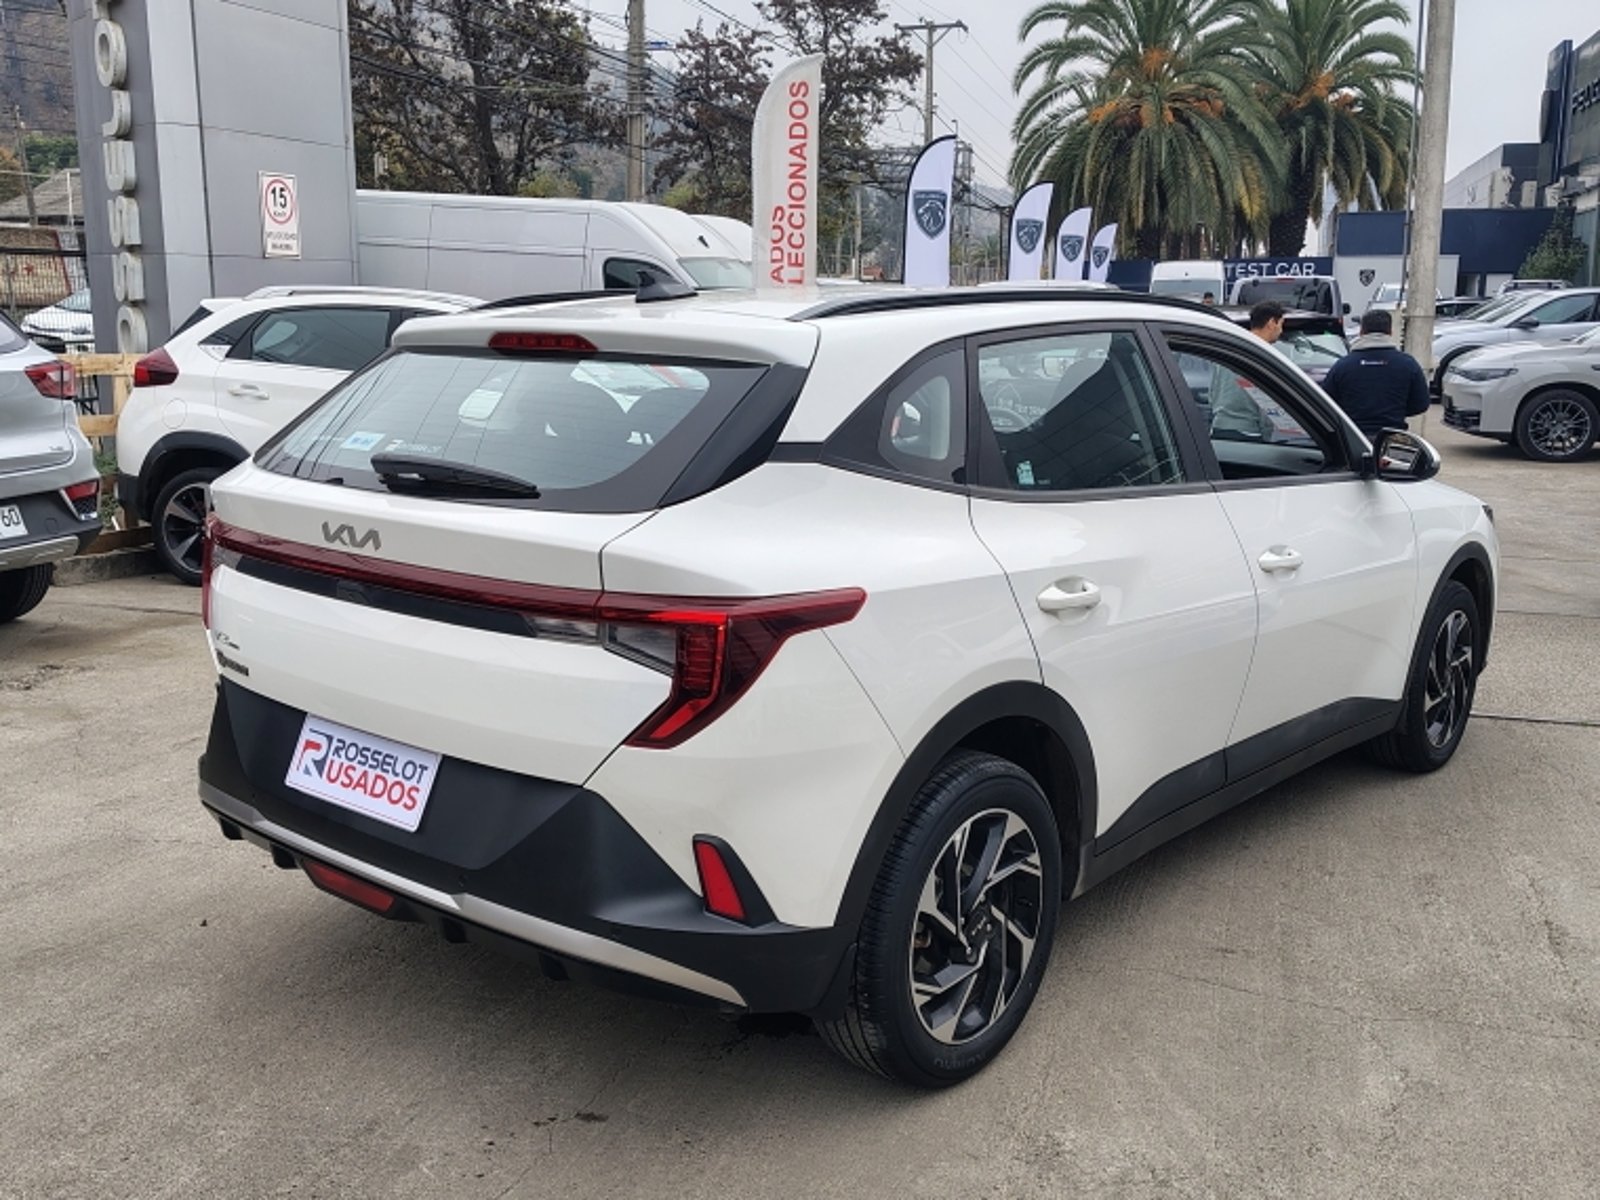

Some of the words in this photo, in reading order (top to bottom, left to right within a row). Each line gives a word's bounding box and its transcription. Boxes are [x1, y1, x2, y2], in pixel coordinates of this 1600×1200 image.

[271, 186, 287, 208] 15
[787, 80, 809, 285] LECCIONADOS
[1225, 262, 1271, 278] TEST
[1275, 262, 1316, 277] CAR
[321, 521, 382, 552] KIA
[332, 738, 428, 784] ROSSELOT
[326, 759, 420, 811] USADOS
